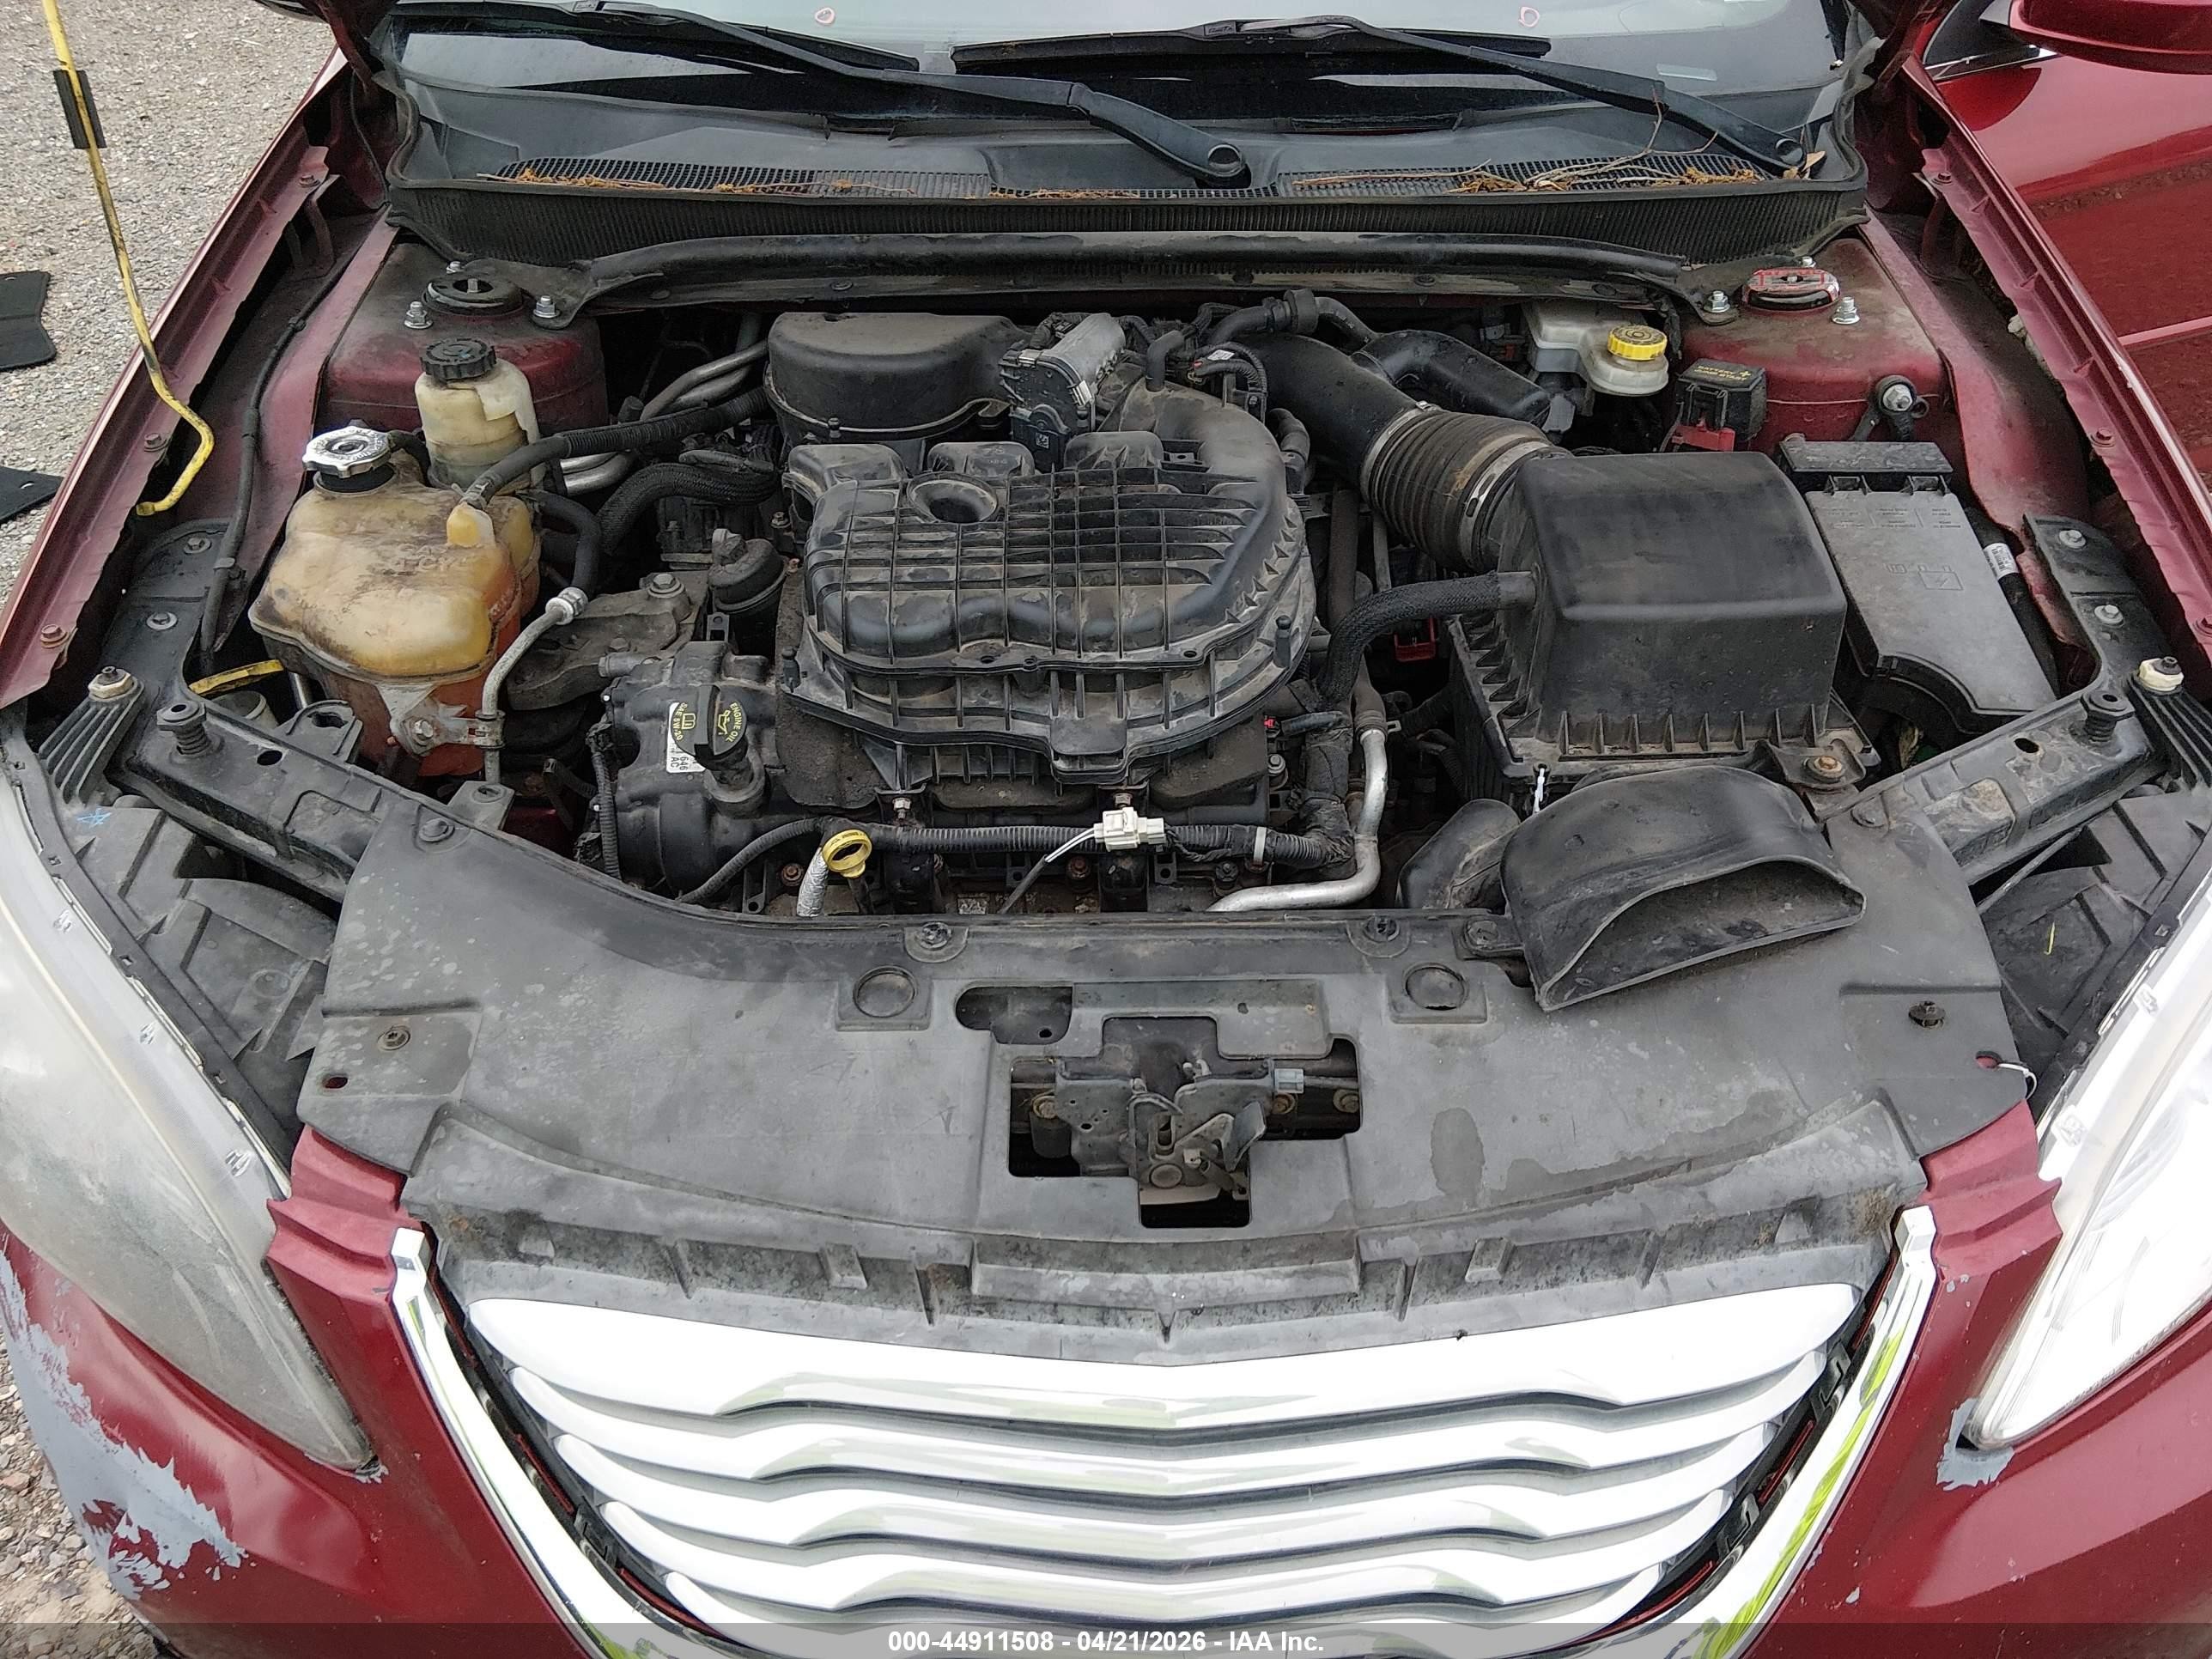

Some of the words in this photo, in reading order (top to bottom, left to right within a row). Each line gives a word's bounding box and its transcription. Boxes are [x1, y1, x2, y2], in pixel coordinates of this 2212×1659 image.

[675, 702, 688, 716] SAE
[730, 702, 743, 730] ENGINE
[726, 731, 738, 742] OIL
[670, 757, 680, 768] AC
